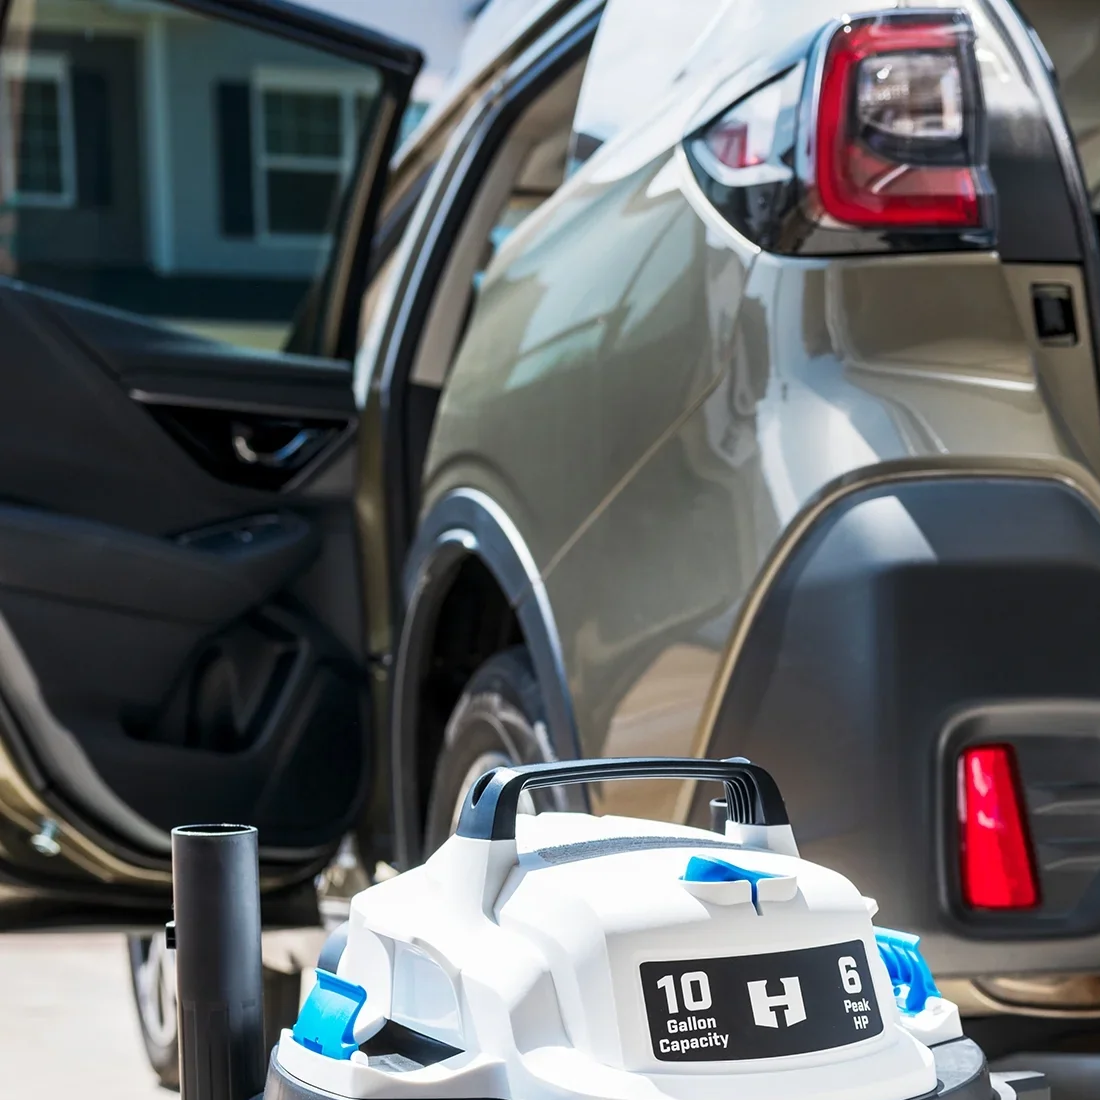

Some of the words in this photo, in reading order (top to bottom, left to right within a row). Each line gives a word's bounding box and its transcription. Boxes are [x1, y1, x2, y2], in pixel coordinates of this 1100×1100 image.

[837, 955, 863, 995] 6
[656, 970, 713, 1015] 10
[843, 998, 872, 1014] Peak
[666, 1015, 717, 1034] Gallon
[852, 1015, 870, 1030] HP
[659, 1032, 729, 1054] Capacity
